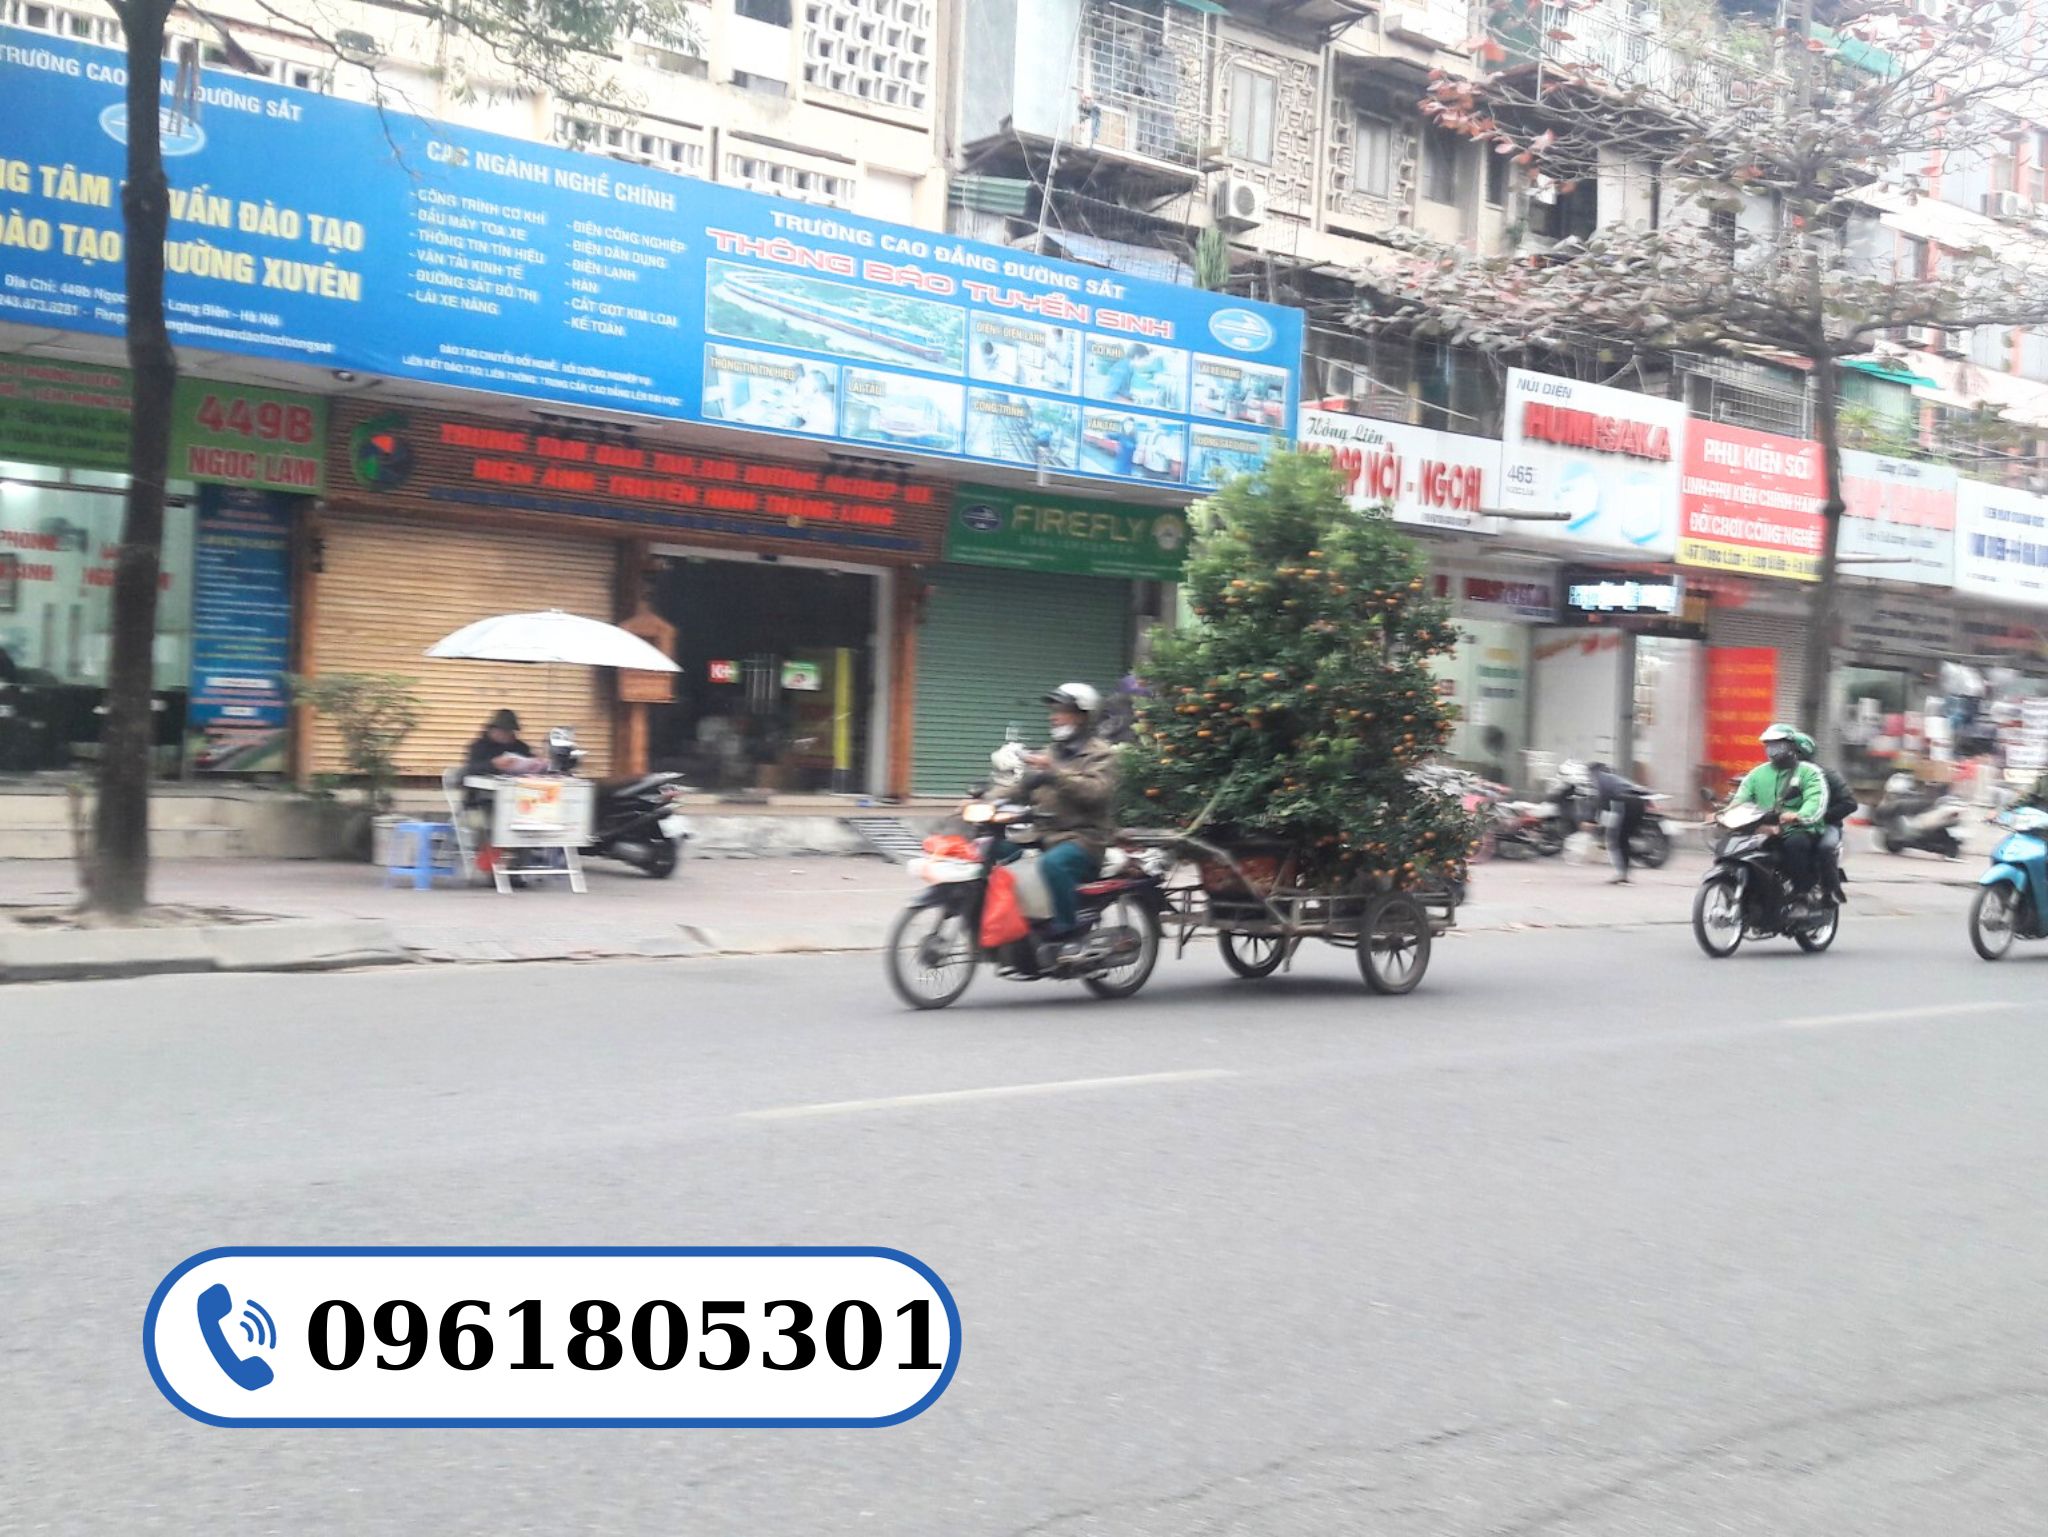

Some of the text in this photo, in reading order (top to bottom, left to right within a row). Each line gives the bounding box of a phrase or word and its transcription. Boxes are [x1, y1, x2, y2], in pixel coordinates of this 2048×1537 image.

[86, 62, 128, 86] CAO
[39, 161, 111, 207] TÂM
[476, 150, 549, 185] NGÀNH
[614, 179, 677, 212] CHÍNH
[169, 181, 365, 253] VẤN ĐÀO TẠO
[60, 223, 122, 266] TẠO
[770, 210, 1127, 299] TRƯỜNG CAO ĐẲNG ĐƯỜNG SẮT
[262, 255, 363, 301] XUYÊN
[706, 227, 857, 277] THÔNG
[1096, 308, 1176, 340] SINH
[198, 394, 315, 444] 449B
[1507, 465, 1533, 484] 465
[1011, 504, 1147, 542] FIREFLY
